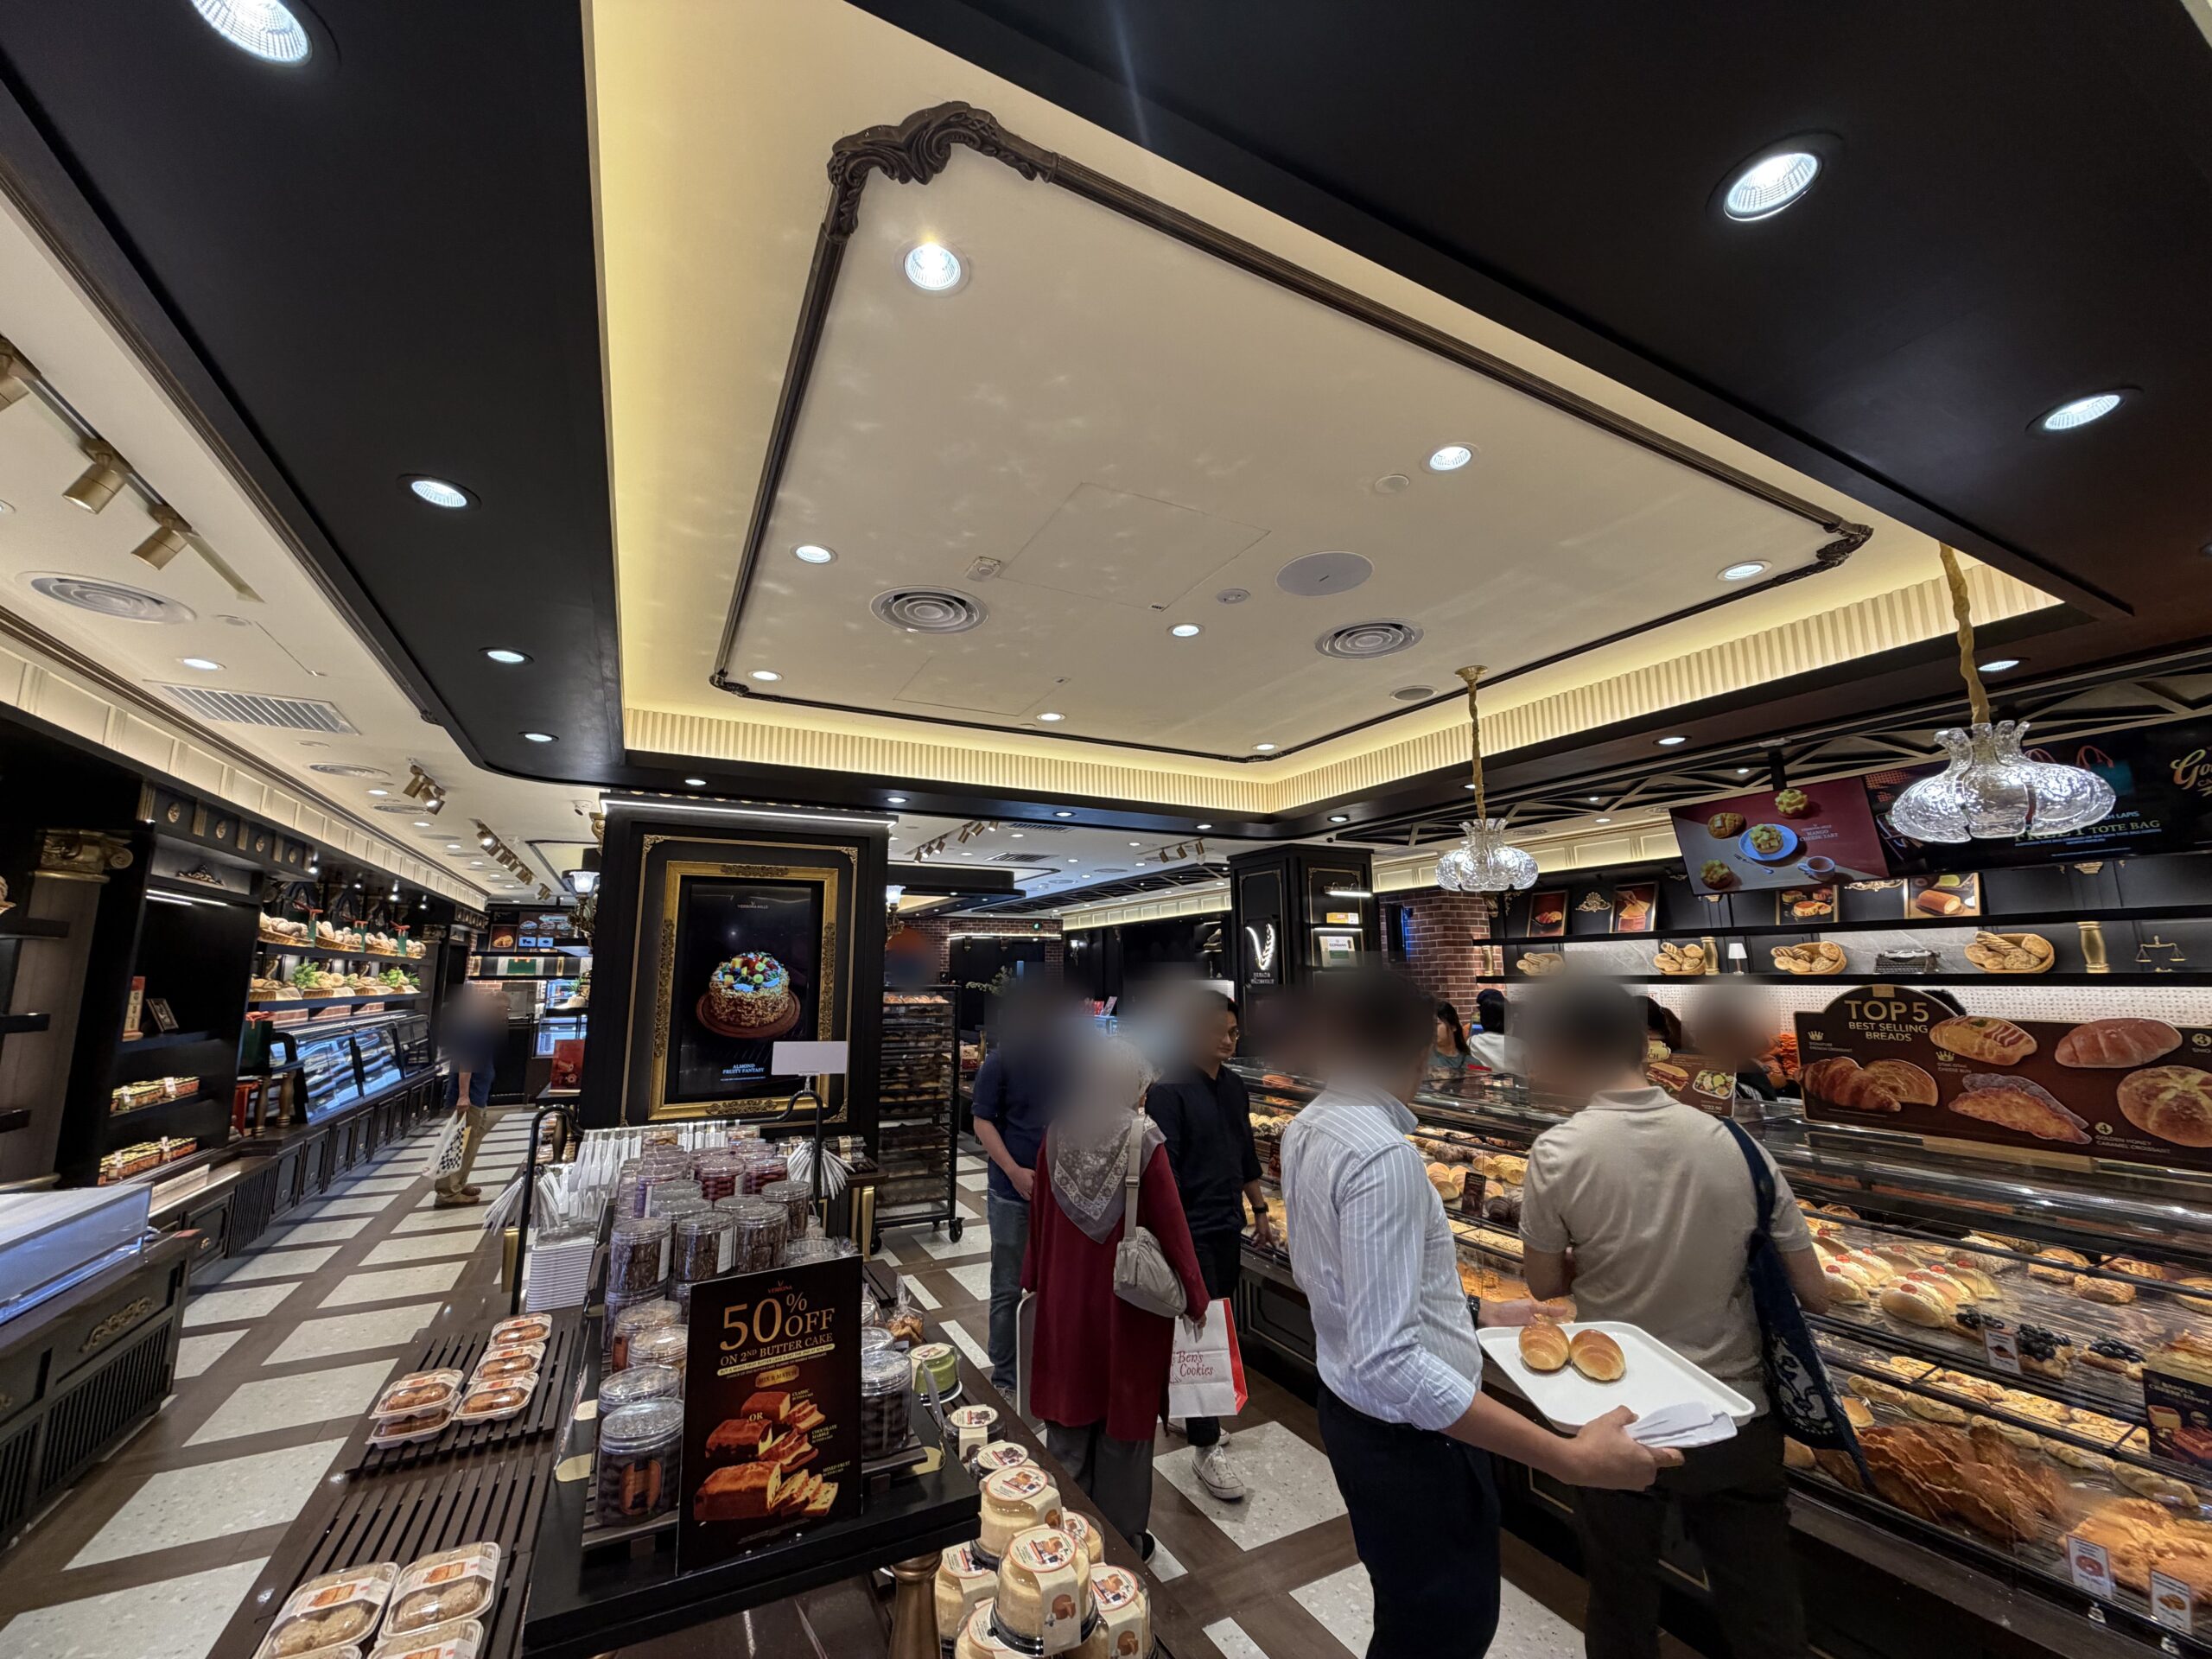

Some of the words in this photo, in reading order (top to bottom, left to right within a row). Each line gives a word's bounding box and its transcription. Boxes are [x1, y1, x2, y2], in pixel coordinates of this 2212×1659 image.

[2116, 810, 2140, 819] LAPIS
[2088, 821, 2127, 834] TOTE
[2130, 820, 2161, 830] BAG
[1844, 1000, 1909, 1022] TOP
[1912, 1001, 1929, 1023] 5
[1848, 1021, 1876, 1031] BEST
[1879, 1022, 1929, 1034] SELLING
[1866, 1031, 1912, 1043] BREADS
[785, 1307, 836, 1338] OFF
[720, 1353, 739, 1366] ON
[740, 1349, 758, 1363] 2ND
[760, 1339, 803, 1358] BUTTER
[804, 1332, 834, 1347] CAKE
[1176, 1350, 1204, 1363] Ben's
[1180, 1363, 1214, 1377] Cookies
[749, 1412, 764, 1422] OR
